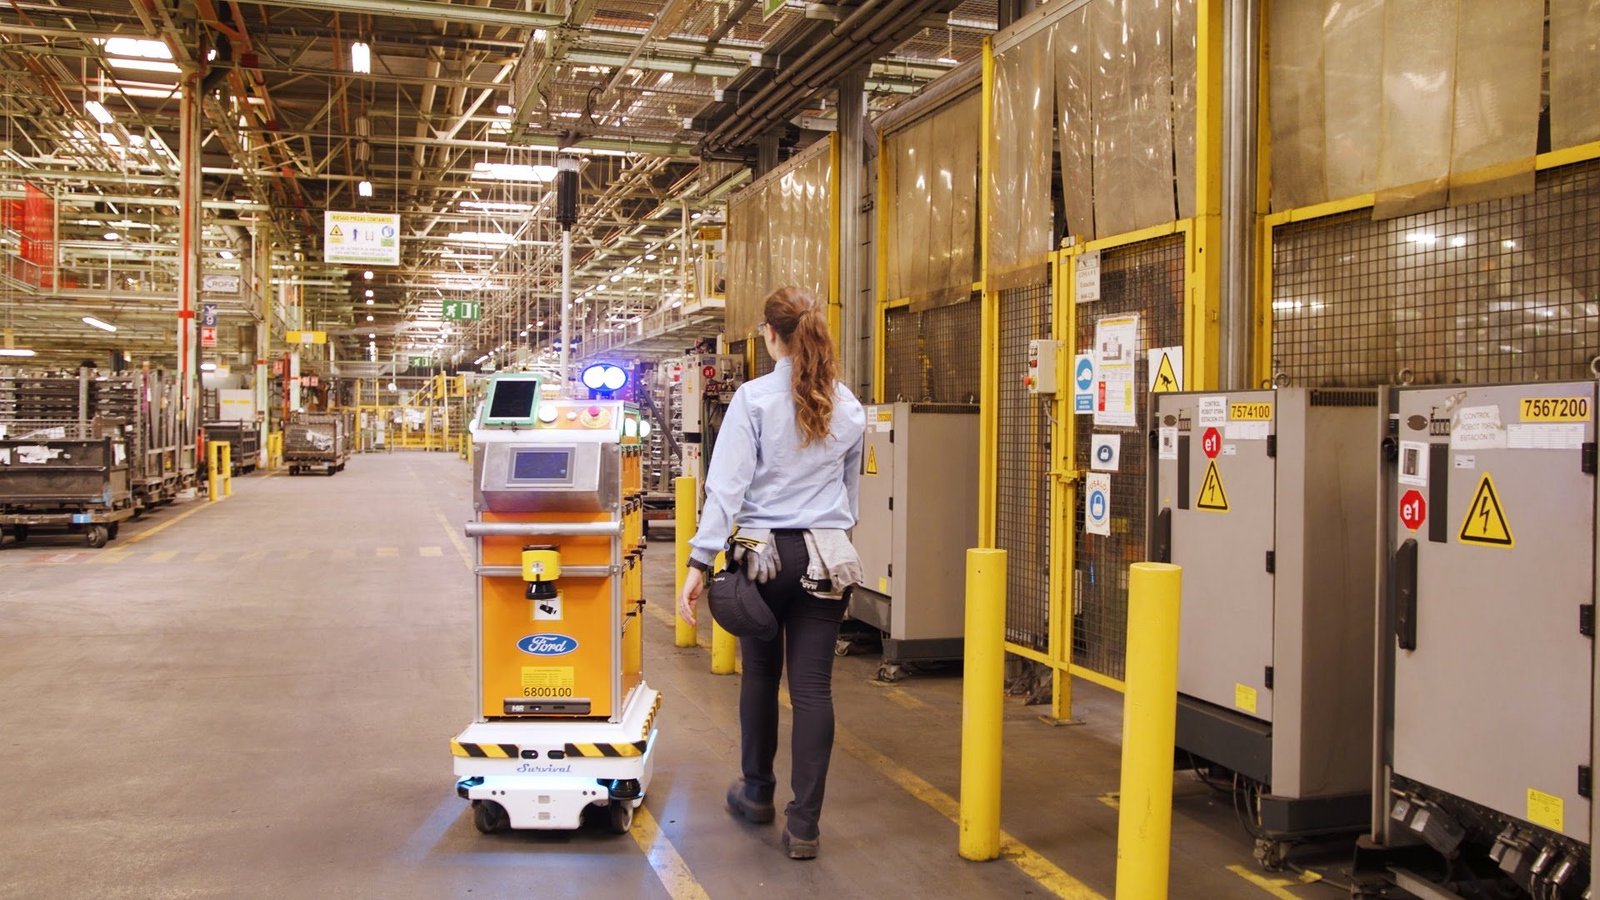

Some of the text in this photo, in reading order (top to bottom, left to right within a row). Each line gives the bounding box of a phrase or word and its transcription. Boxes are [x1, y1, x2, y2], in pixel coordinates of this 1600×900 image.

[1231, 404, 1271, 419] 7574100
[1464, 411, 1490, 420] CONTROL
[1524, 398, 1588, 418] 7567200
[1204, 434, 1218, 452] e1
[1403, 499, 1420, 521] e1
[527, 635, 568, 653] Ford
[523, 687, 573, 698] 6800100
[517, 763, 572, 773] Survival
